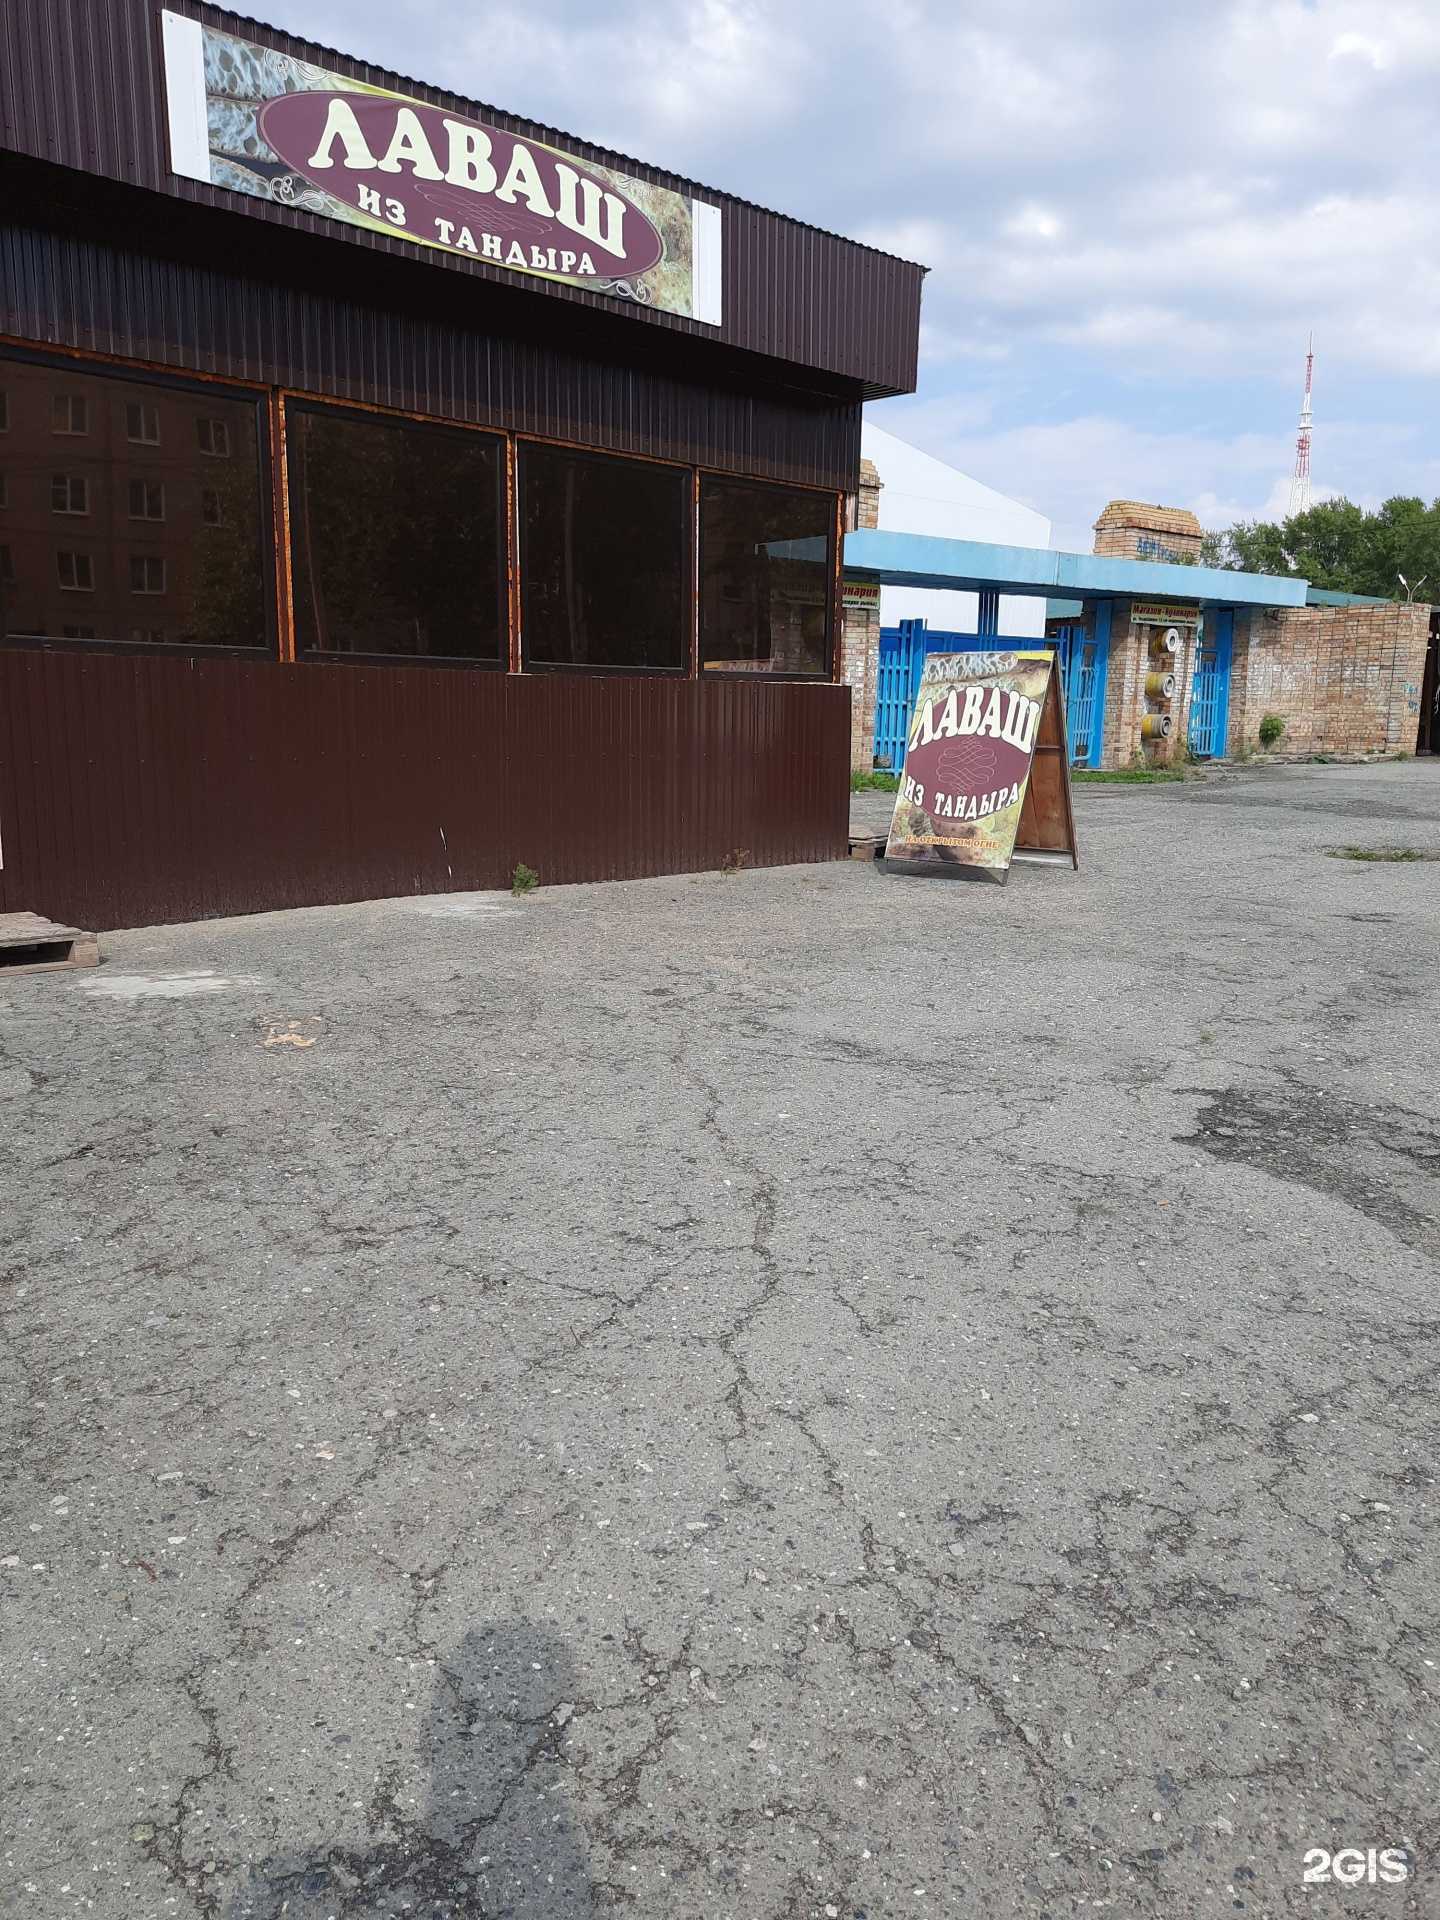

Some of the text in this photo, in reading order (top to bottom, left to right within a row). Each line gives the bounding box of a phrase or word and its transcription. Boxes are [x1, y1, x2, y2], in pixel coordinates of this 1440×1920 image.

[308, 98, 627, 259] ЛАВАШ
[357, 183, 598, 275] ИЗ ТАНДЫРА
[908, 686, 1040, 754] ЛАВАШ
[904, 775, 1020, 820] ИЗ ТАНДЫРА
